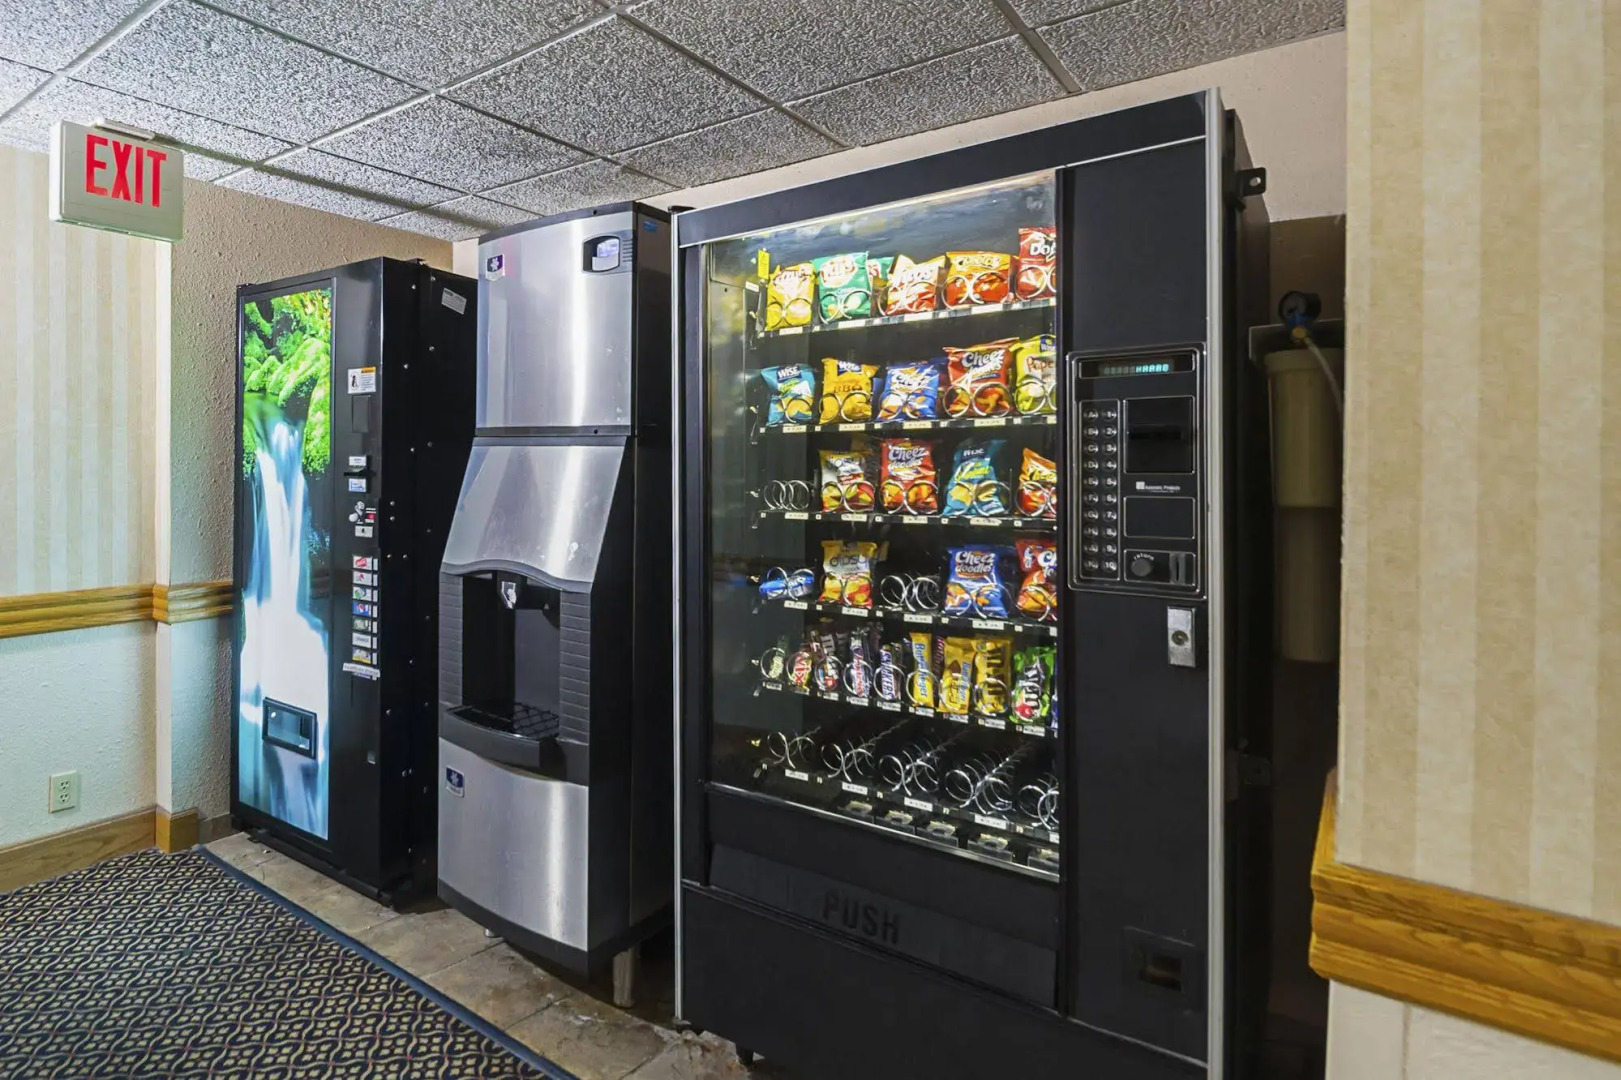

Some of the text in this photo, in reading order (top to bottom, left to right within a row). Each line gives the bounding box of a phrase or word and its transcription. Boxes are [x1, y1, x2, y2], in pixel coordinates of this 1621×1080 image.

[86, 134, 167, 208] EXIT
[955, 551, 995, 565] Cheez
[955, 563, 993, 574] doodles
[793, 653, 812, 685] wix
[881, 652, 895, 700] SNCKERS
[822, 889, 899, 945] PUSH
